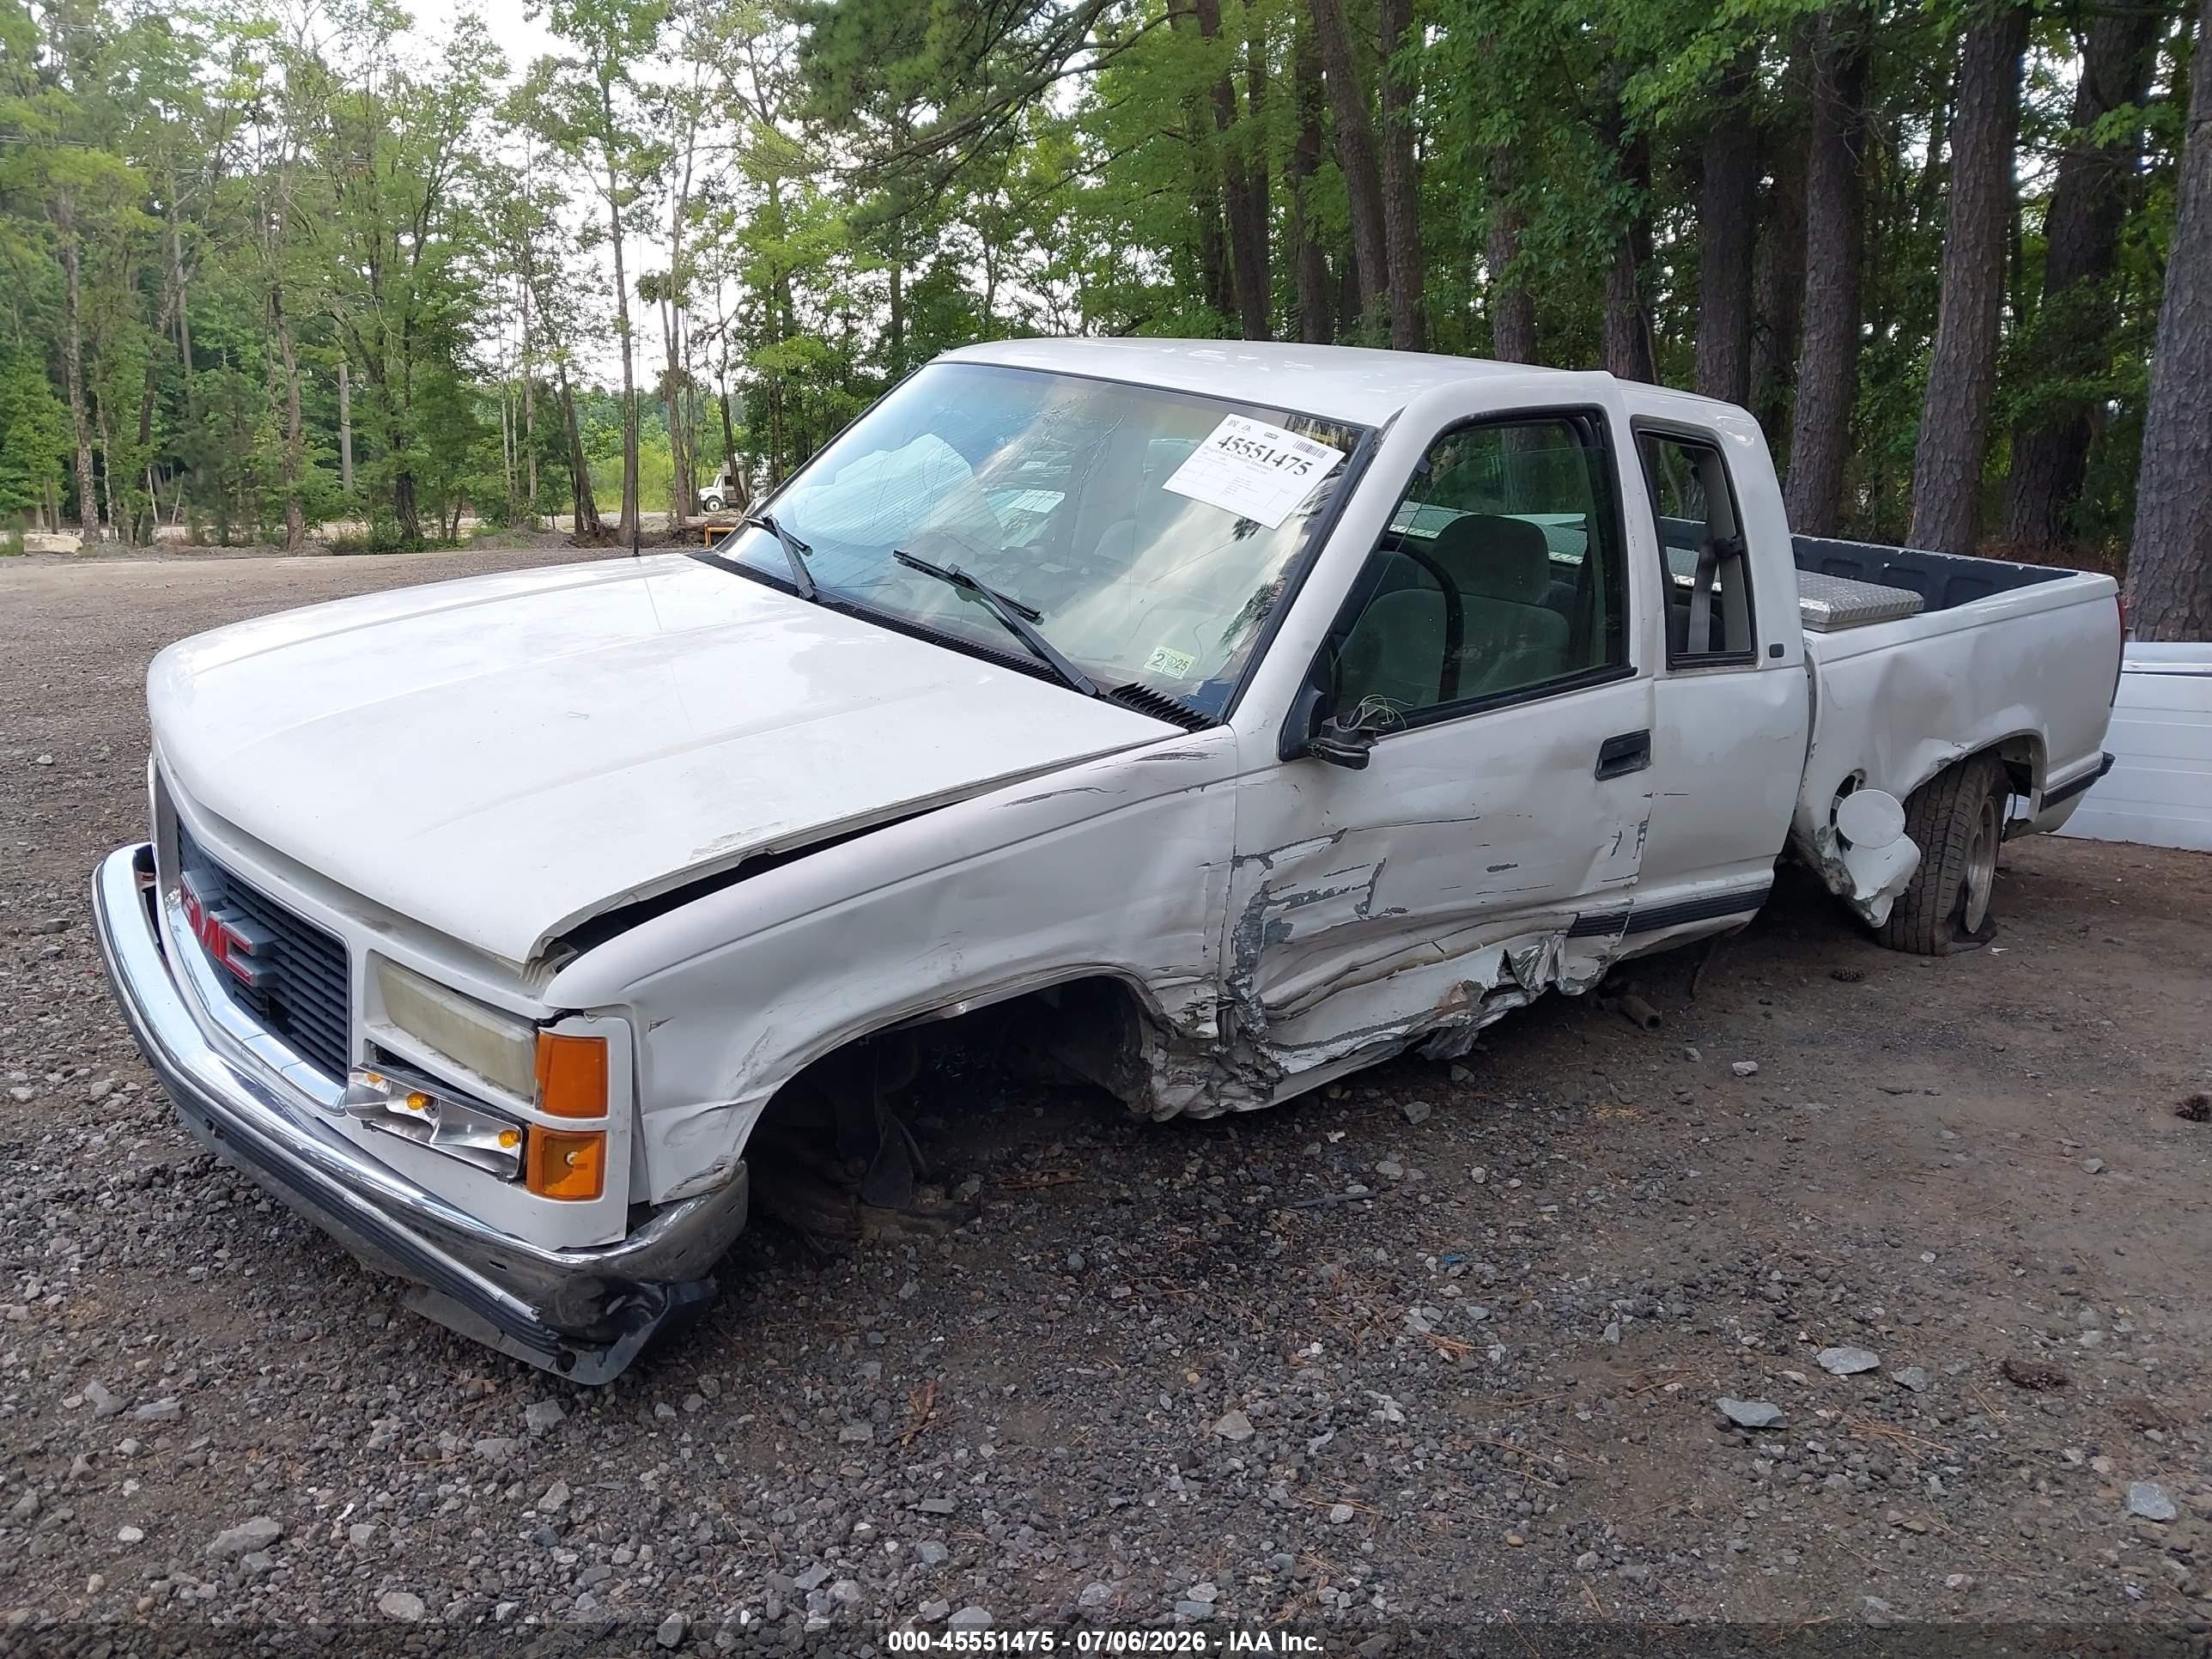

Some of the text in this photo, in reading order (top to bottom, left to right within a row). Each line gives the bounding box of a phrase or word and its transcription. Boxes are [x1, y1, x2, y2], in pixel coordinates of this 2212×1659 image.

[1217, 434, 1315, 476] 45551475
[1150, 653, 1189, 671] 2 25
[179, 872, 258, 988] GMC
